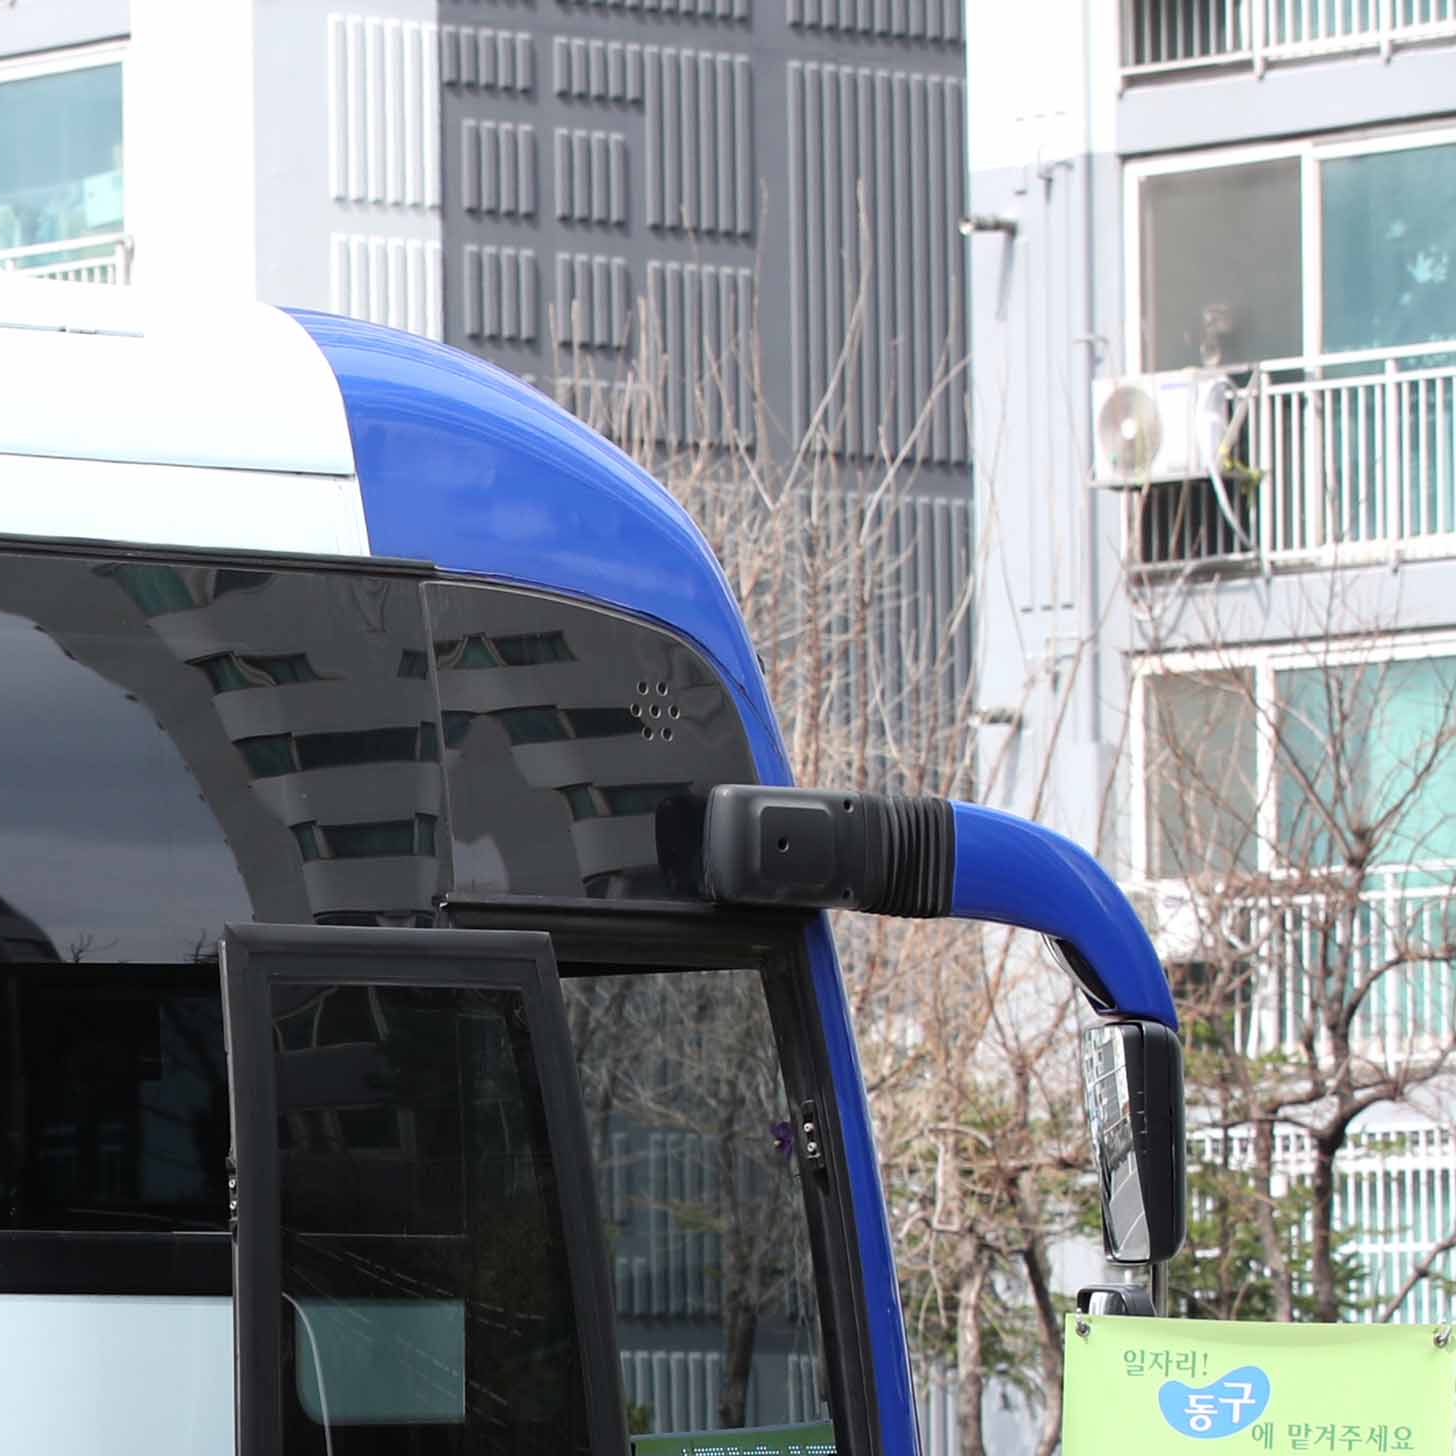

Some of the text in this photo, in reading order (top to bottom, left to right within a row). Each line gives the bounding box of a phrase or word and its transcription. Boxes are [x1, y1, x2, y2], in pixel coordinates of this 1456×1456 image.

[1123, 1350, 1209, 1378] 일자리!
[1183, 1381, 1415, 1452] 동구 에 맡겨주세요
